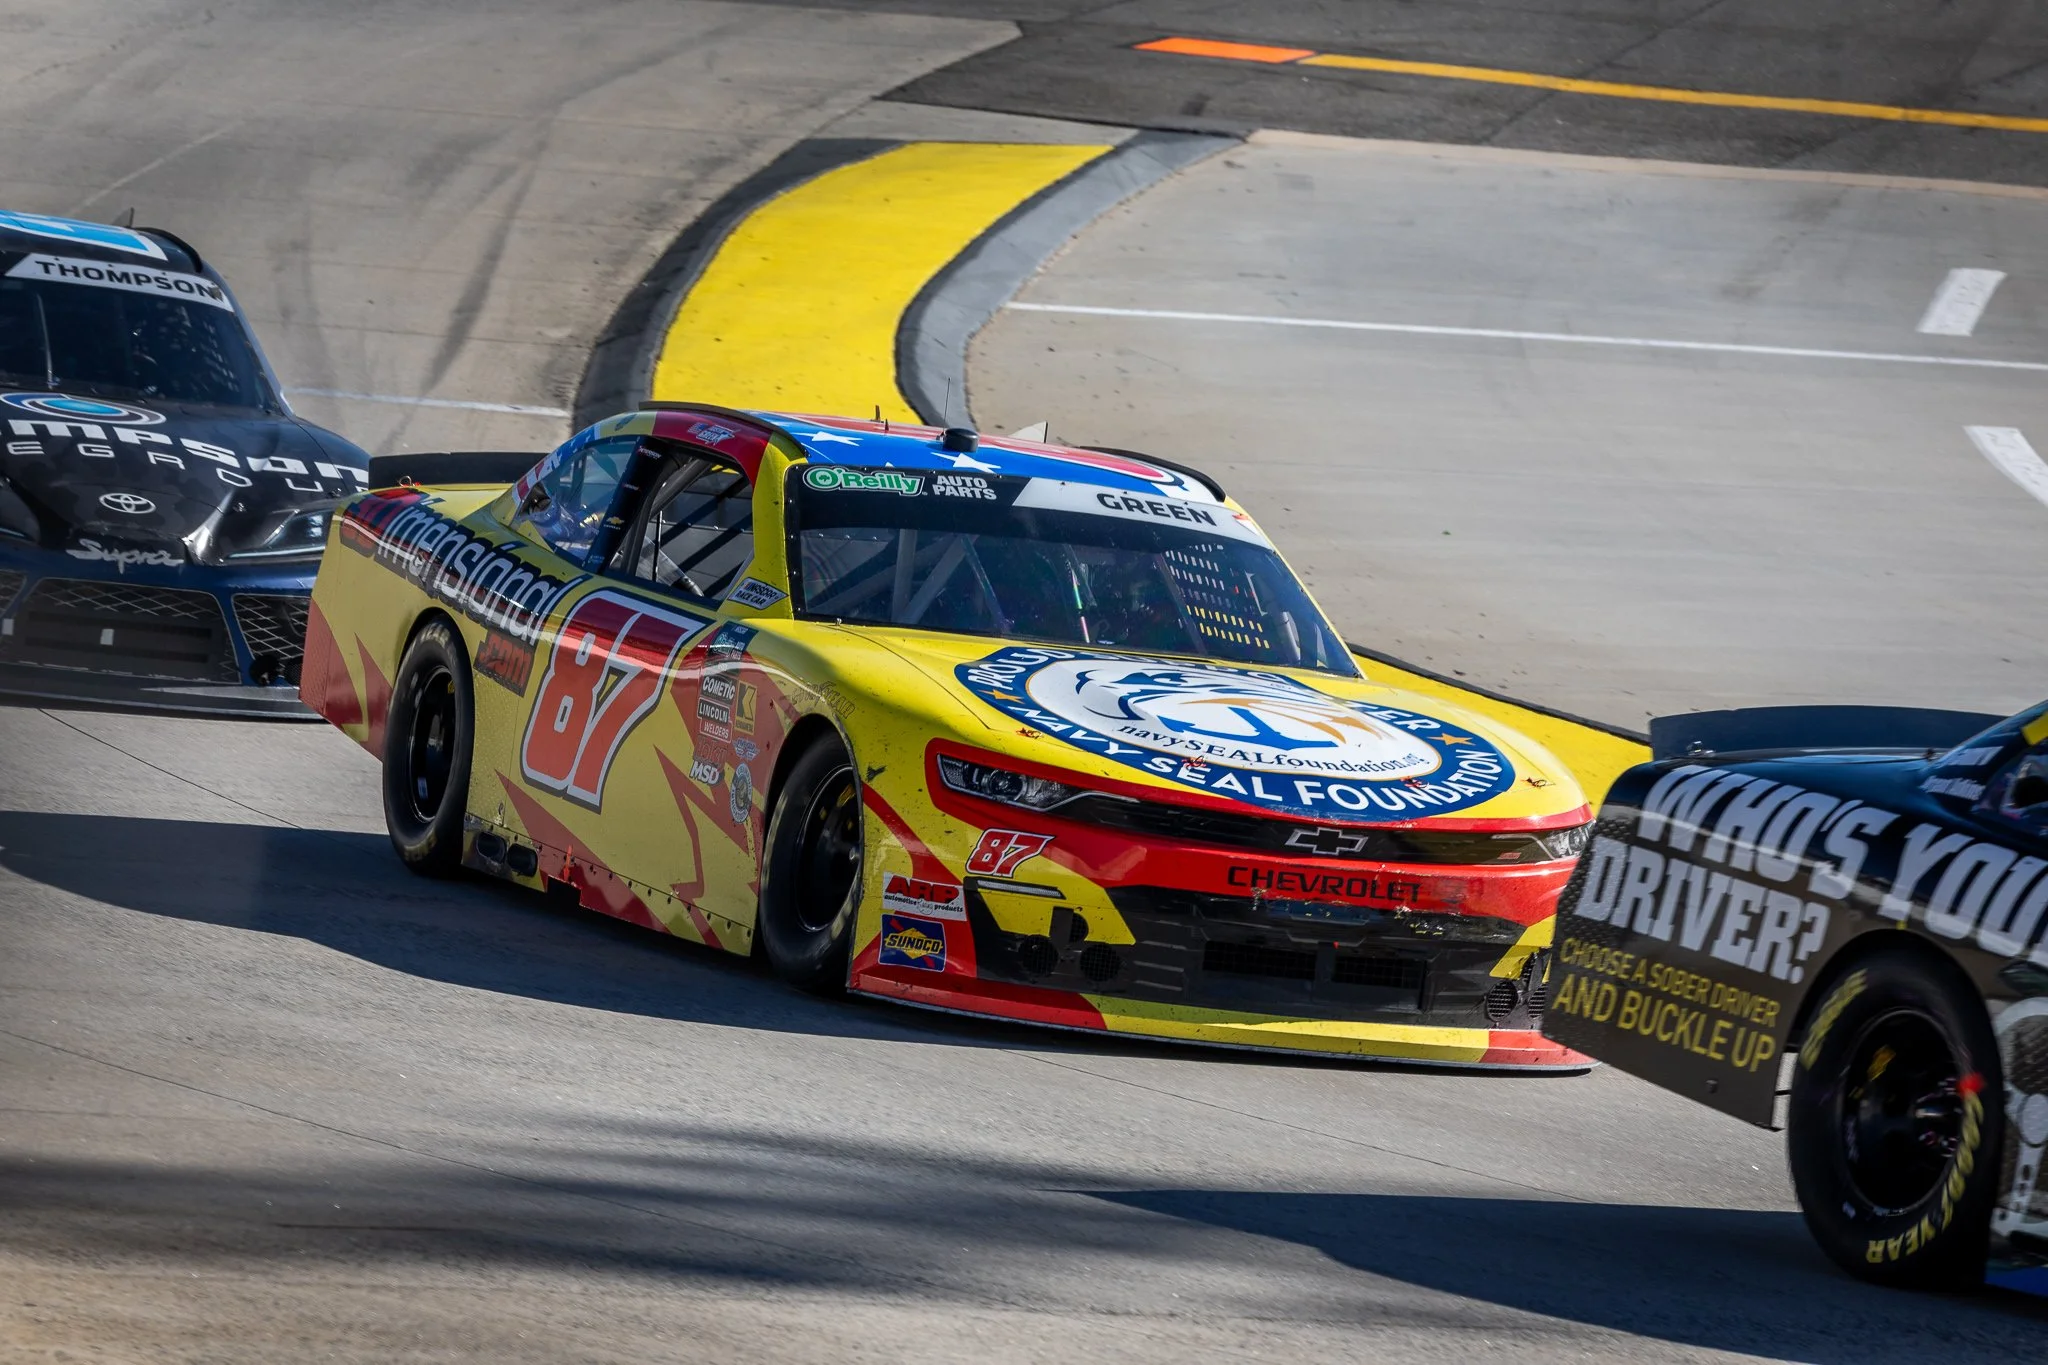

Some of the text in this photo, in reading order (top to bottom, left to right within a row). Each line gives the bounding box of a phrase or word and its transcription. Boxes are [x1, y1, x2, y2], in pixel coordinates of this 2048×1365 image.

[35, 260, 225, 303] THOMPSON
[806, 466, 922, 496] O'Reilly
[932, 485, 997, 500] PARTS
[937, 475, 988, 489] AUTO
[1097, 493, 1217, 526] GREEN
[67, 538, 185, 574] Supra
[968, 648, 1076, 691] PROUD
[521, 587, 714, 814] 87
[702, 677, 736, 700] COMETIC
[699, 702, 728, 723] LINCOLN
[703, 721, 730, 739] WELDERS
[690, 760, 720, 785] MSD
[1007, 706, 1502, 811] NAVY SEAL FOUNDATION
[965, 828, 1056, 879] 87
[1637, 765, 2048, 968] WHO'S YOU
[885, 874, 960, 904] ARP
[1227, 865, 1423, 903] CHEVROLET
[934, 903, 964, 914] products
[1575, 837, 1831, 985] DRIVER?
[886, 934, 943, 954] SUNOCO
[1559, 937, 1636, 980] CHOOSE
[1631, 958, 1648, 984] A
[1647, 962, 1712, 1004] SOBER
[1709, 982, 1781, 1028] DRIVER
[1551, 973, 1777, 1073] AND BUCKLE UP
